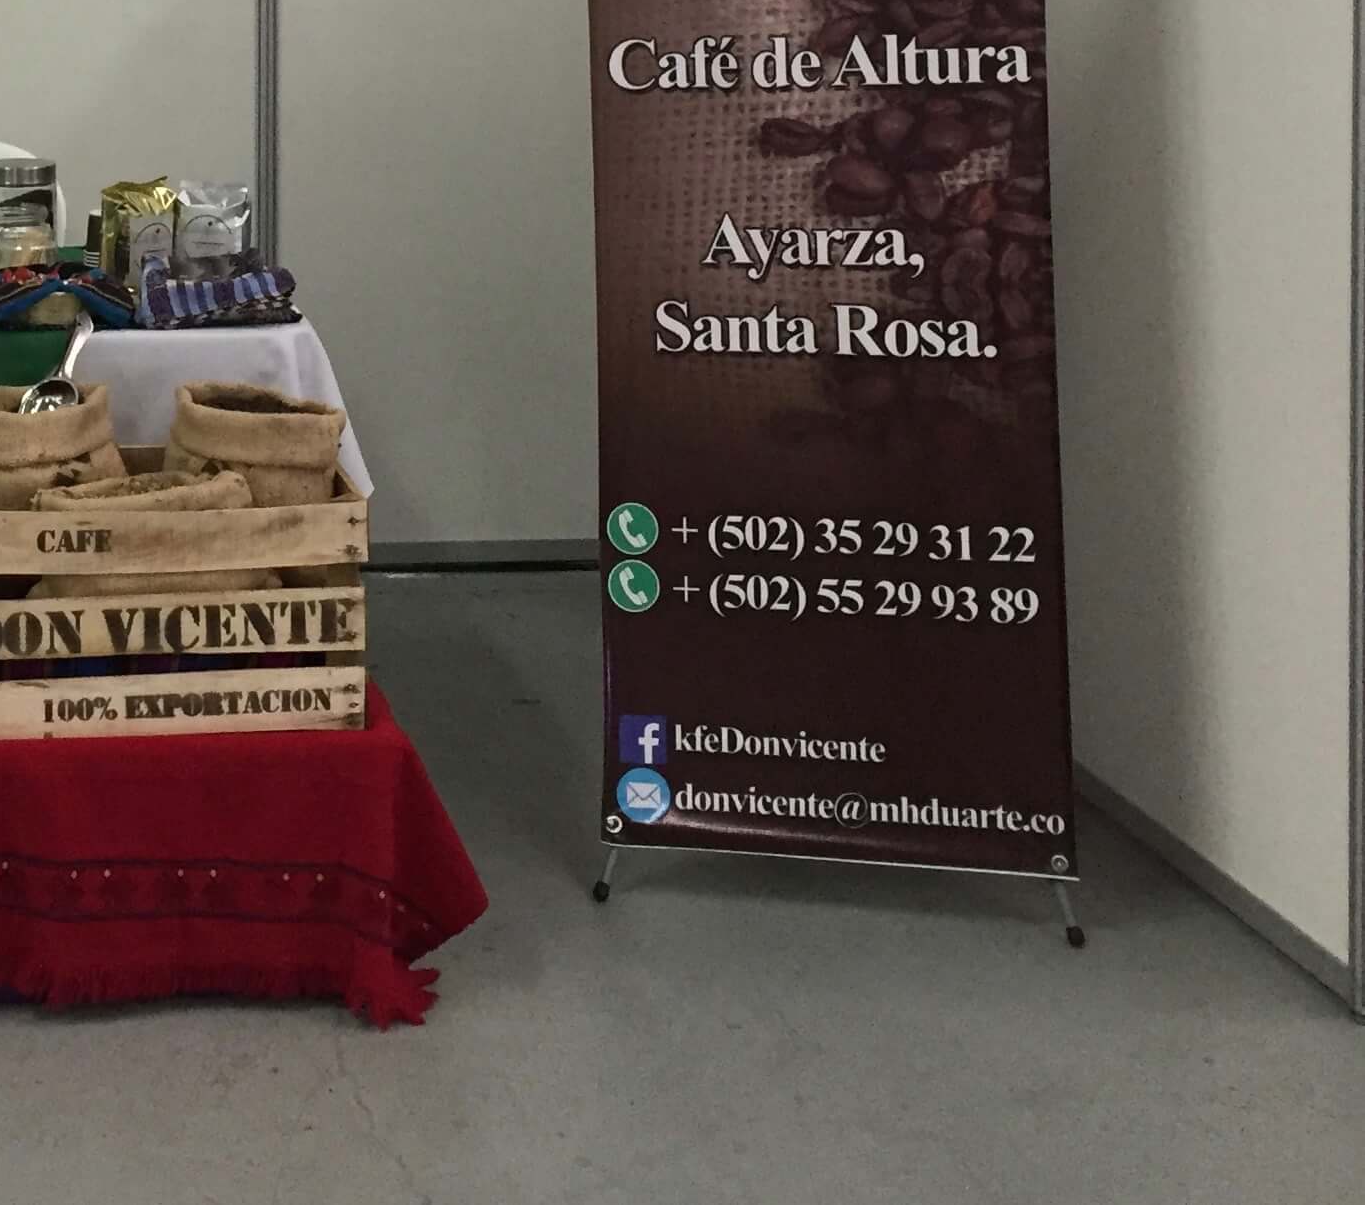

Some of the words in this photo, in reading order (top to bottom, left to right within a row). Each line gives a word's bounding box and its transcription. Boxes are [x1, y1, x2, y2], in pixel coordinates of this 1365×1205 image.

[610, 38, 736, 89] Café
[754, 38, 819, 87] de
[833, 35, 1029, 85] Altura
[704, 214, 923, 278] Ayarza,
[657, 301, 817, 352] Santa
[834, 306, 996, 357] Rosa.
[37, 530, 112, 553] CAFE
[709, 516, 804, 559] (502)
[815, 519, 861, 553] 35
[874, 521, 917, 555] 29
[929, 525, 970, 560] 31
[989, 527, 1034, 561] 22
[710, 575, 806, 617] (502)
[818, 579, 863, 613] 55
[876, 581, 921, 615] 29
[932, 586, 978, 621] 93
[991, 588, 1038, 622] 89
[101, 598, 356, 653] VICENTE
[44, 698, 117, 722] 100%
[124, 688, 333, 719] EXPORTACION
[676, 725, 885, 762] kfeDonvicente
[674, 784, 1065, 835] donvicente@mhduarte.co
